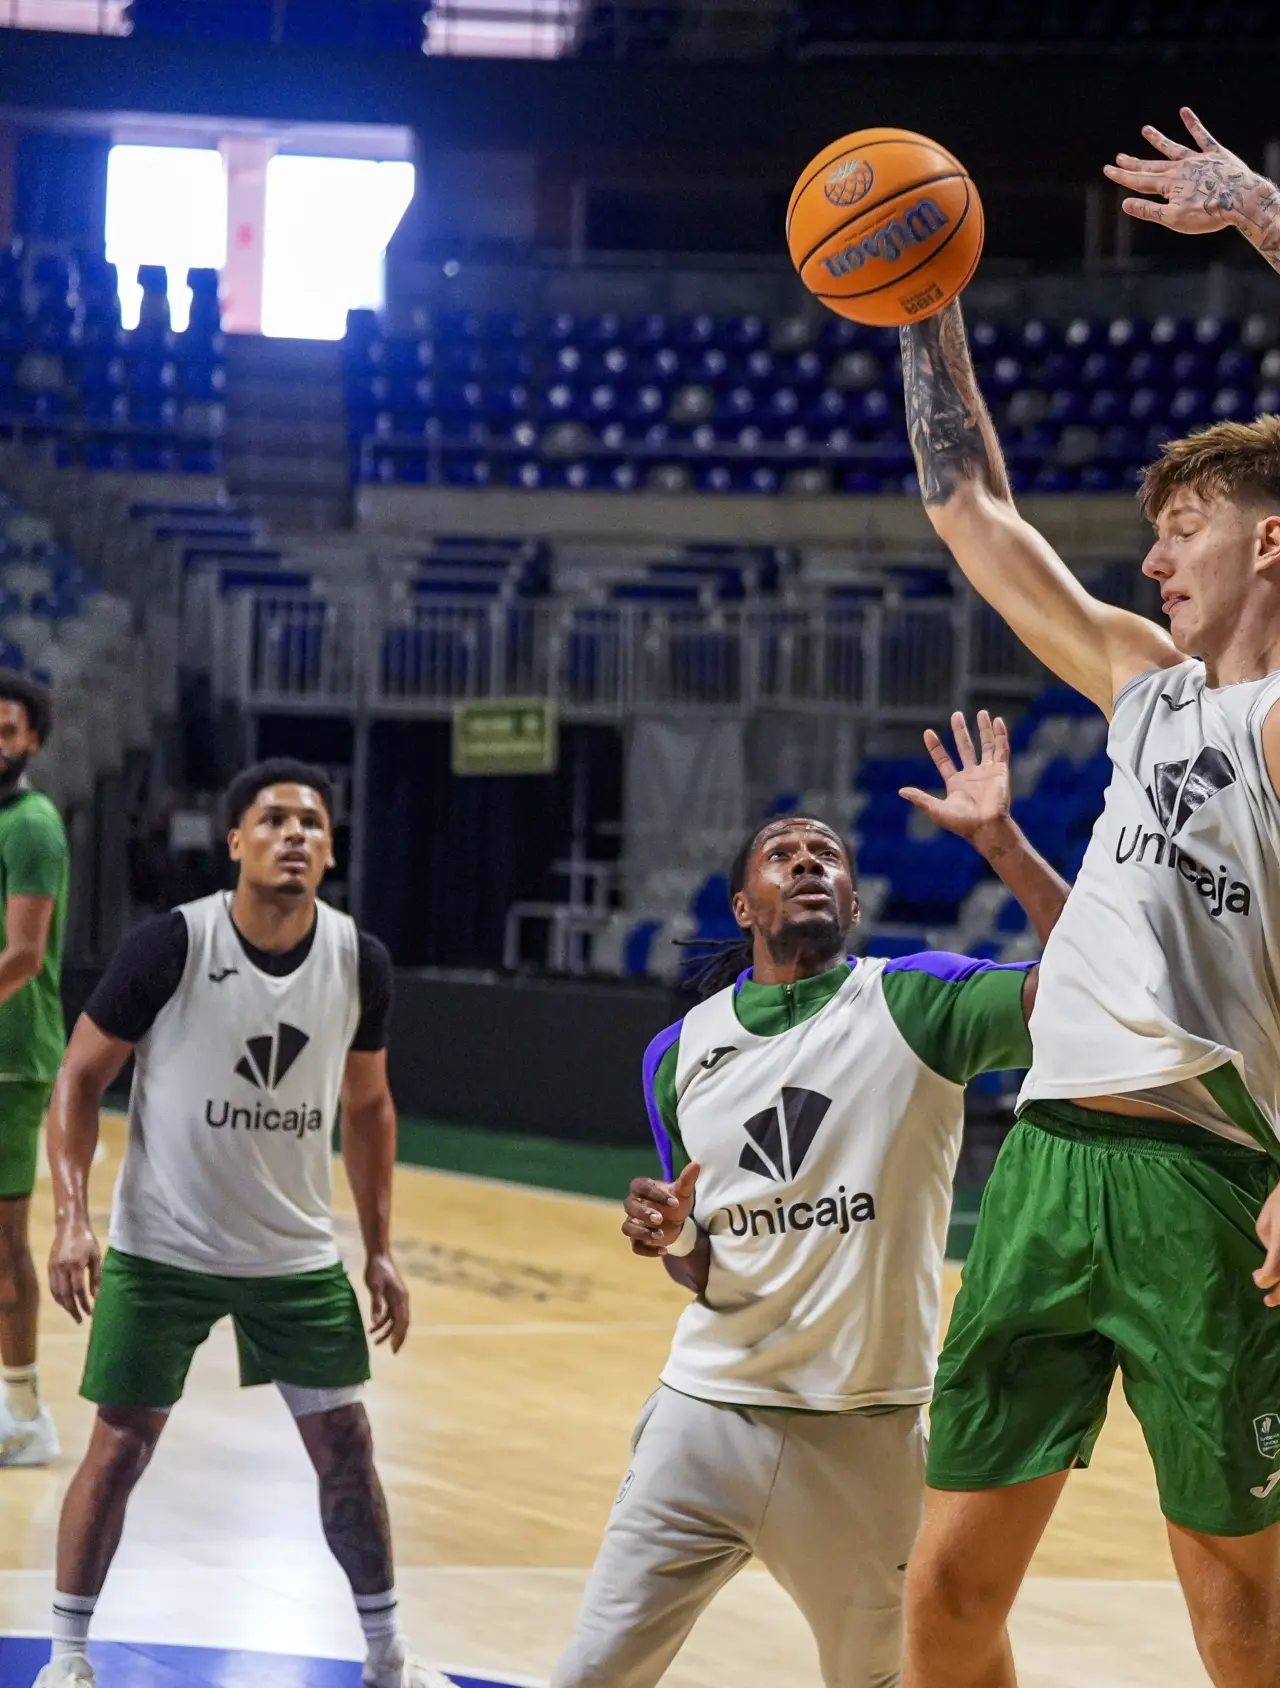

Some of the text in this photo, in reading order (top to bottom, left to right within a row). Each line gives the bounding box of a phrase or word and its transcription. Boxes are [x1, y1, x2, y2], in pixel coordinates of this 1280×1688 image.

[821, 198, 950, 278] Wilson
[1115, 824, 1251, 917] Unicaja
[205, 1100, 322, 1139] Unicaja
[717, 1185, 876, 1237] Unicaja
